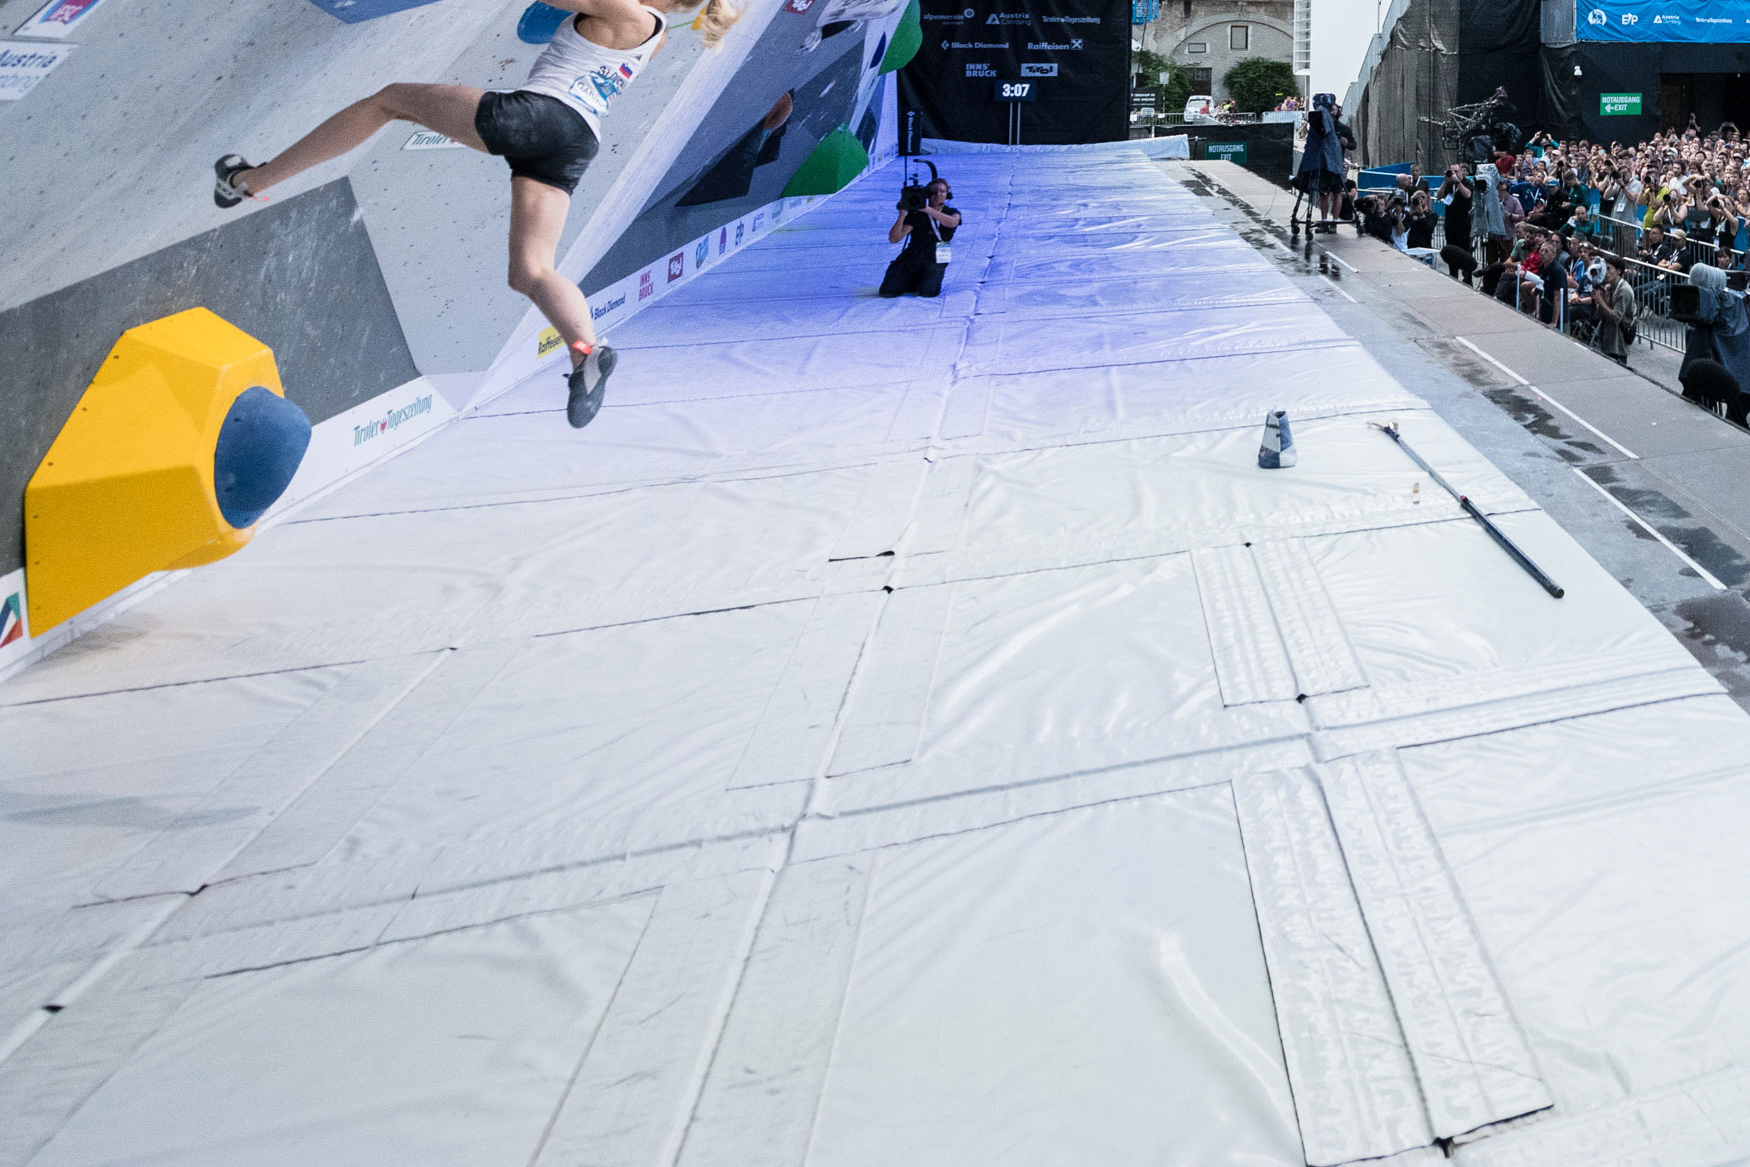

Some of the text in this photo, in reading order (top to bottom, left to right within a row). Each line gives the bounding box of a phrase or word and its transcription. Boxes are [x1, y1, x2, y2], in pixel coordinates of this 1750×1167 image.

[1027, 42, 1070, 51] Raiffeisen
[965, 69, 997, 77] BRUCK
[1002, 84, 1030, 97] 3:07
[1602, 96, 1641, 104] NOTAUSGANG
[1208, 144, 1245, 153] NOTAUSGANG
[594, 304, 608, 320] Black
[353, 394, 433, 447] Tiroler Tageszeitung
